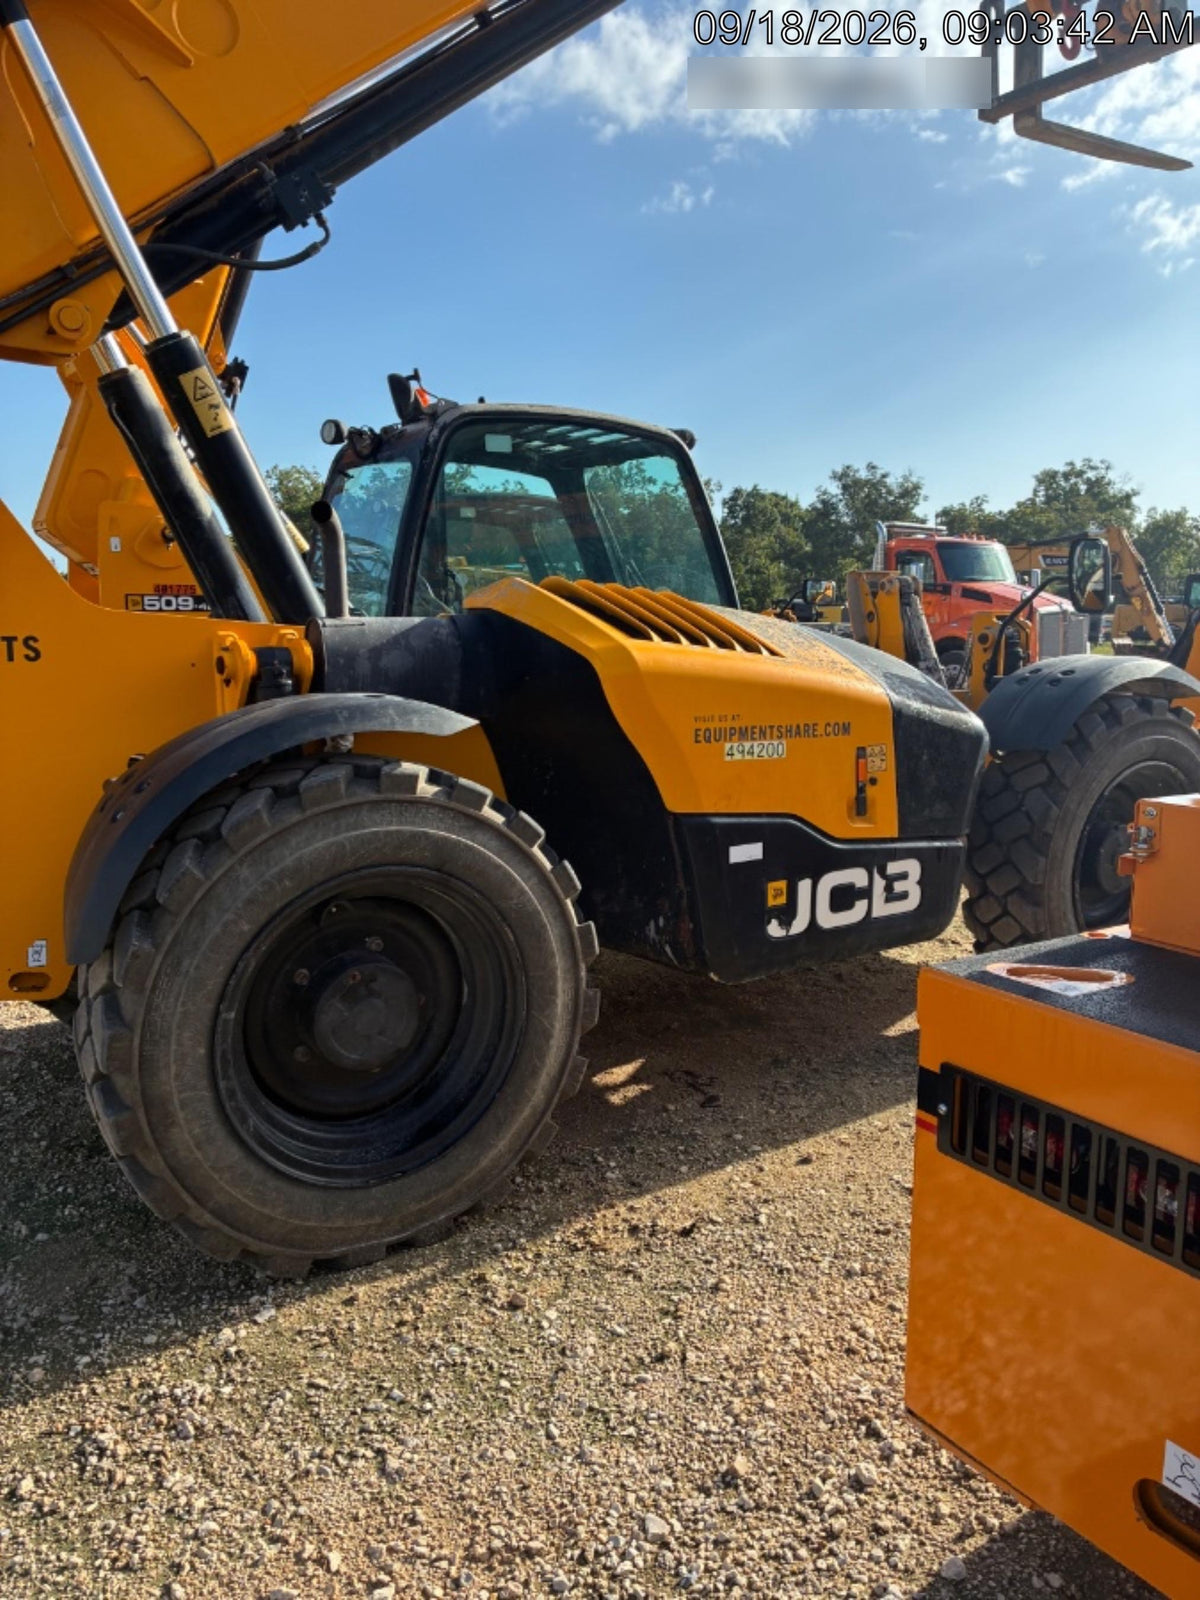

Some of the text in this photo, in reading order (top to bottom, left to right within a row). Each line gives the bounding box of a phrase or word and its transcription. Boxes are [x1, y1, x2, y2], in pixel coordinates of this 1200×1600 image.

[0, 635, 41, 662] TS
[694, 722, 851, 743] EQUIPMENTSHARE.COM
[726, 742, 785, 760] 494200
[766, 858, 922, 938] JCB
